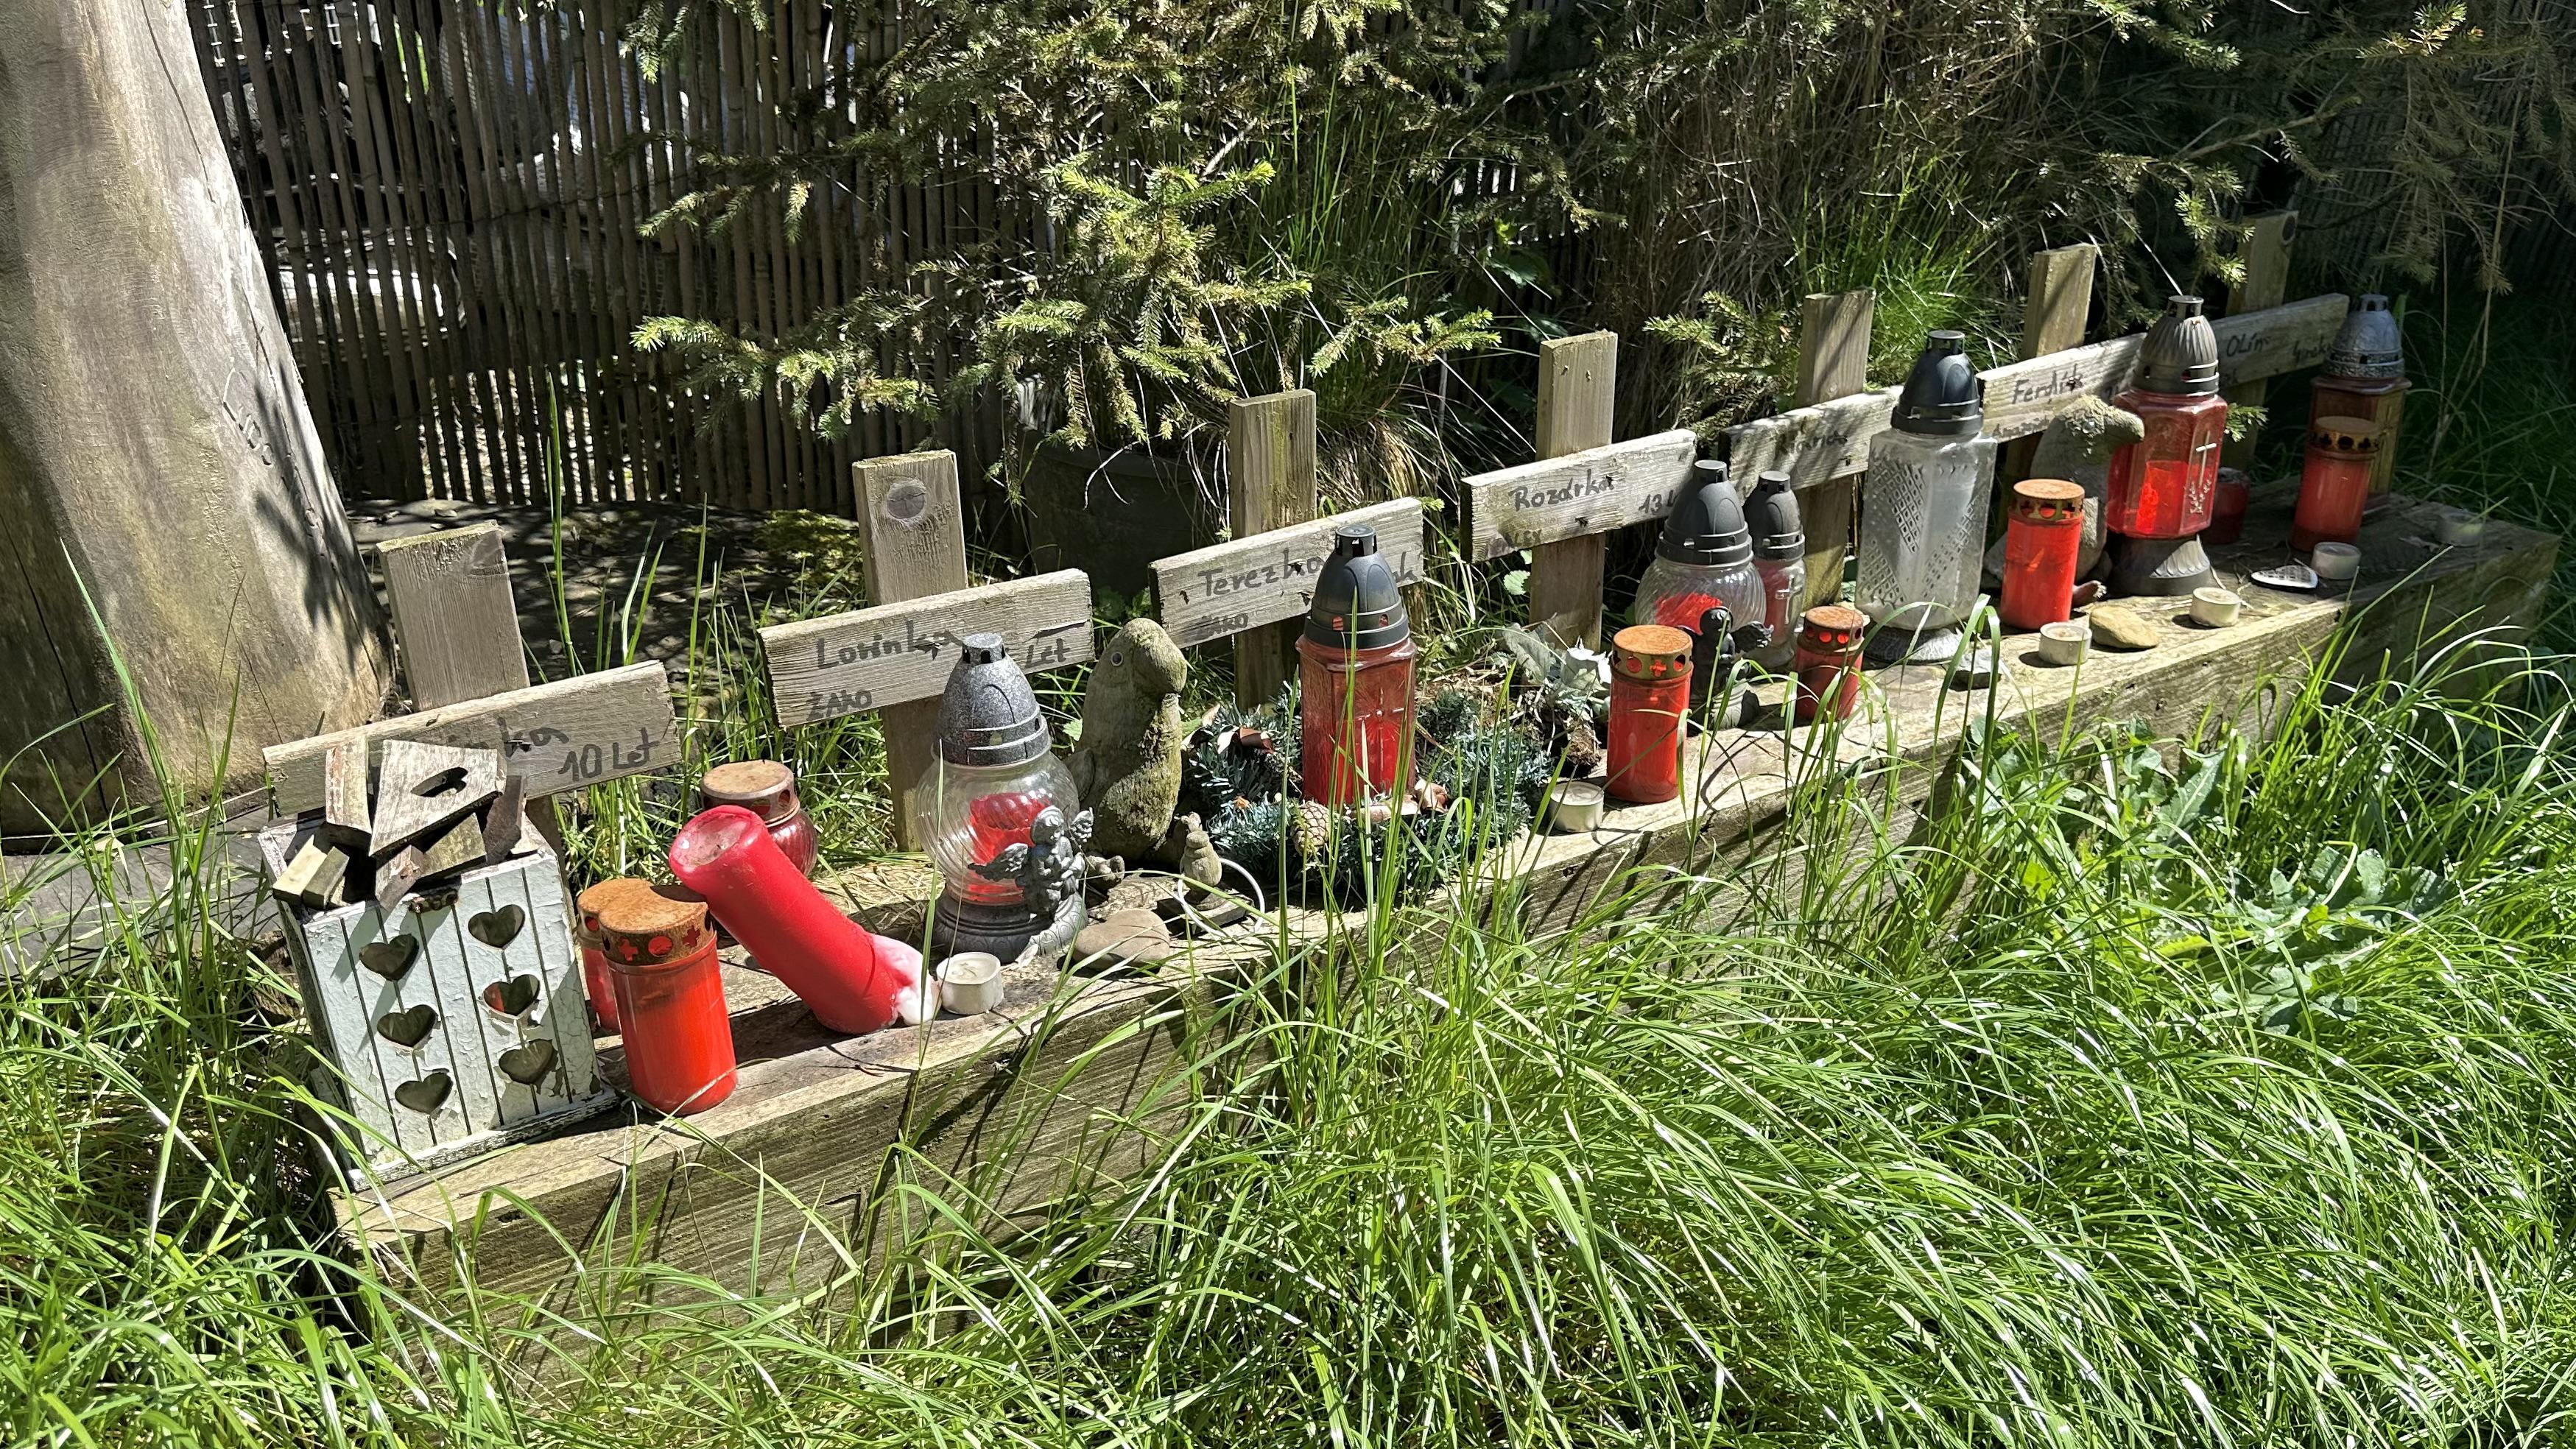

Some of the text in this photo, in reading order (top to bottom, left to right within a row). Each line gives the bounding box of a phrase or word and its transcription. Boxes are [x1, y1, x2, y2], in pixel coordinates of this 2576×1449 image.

[1639, 494, 1662, 515] 13
[557, 727, 661, 781] 10 Let
